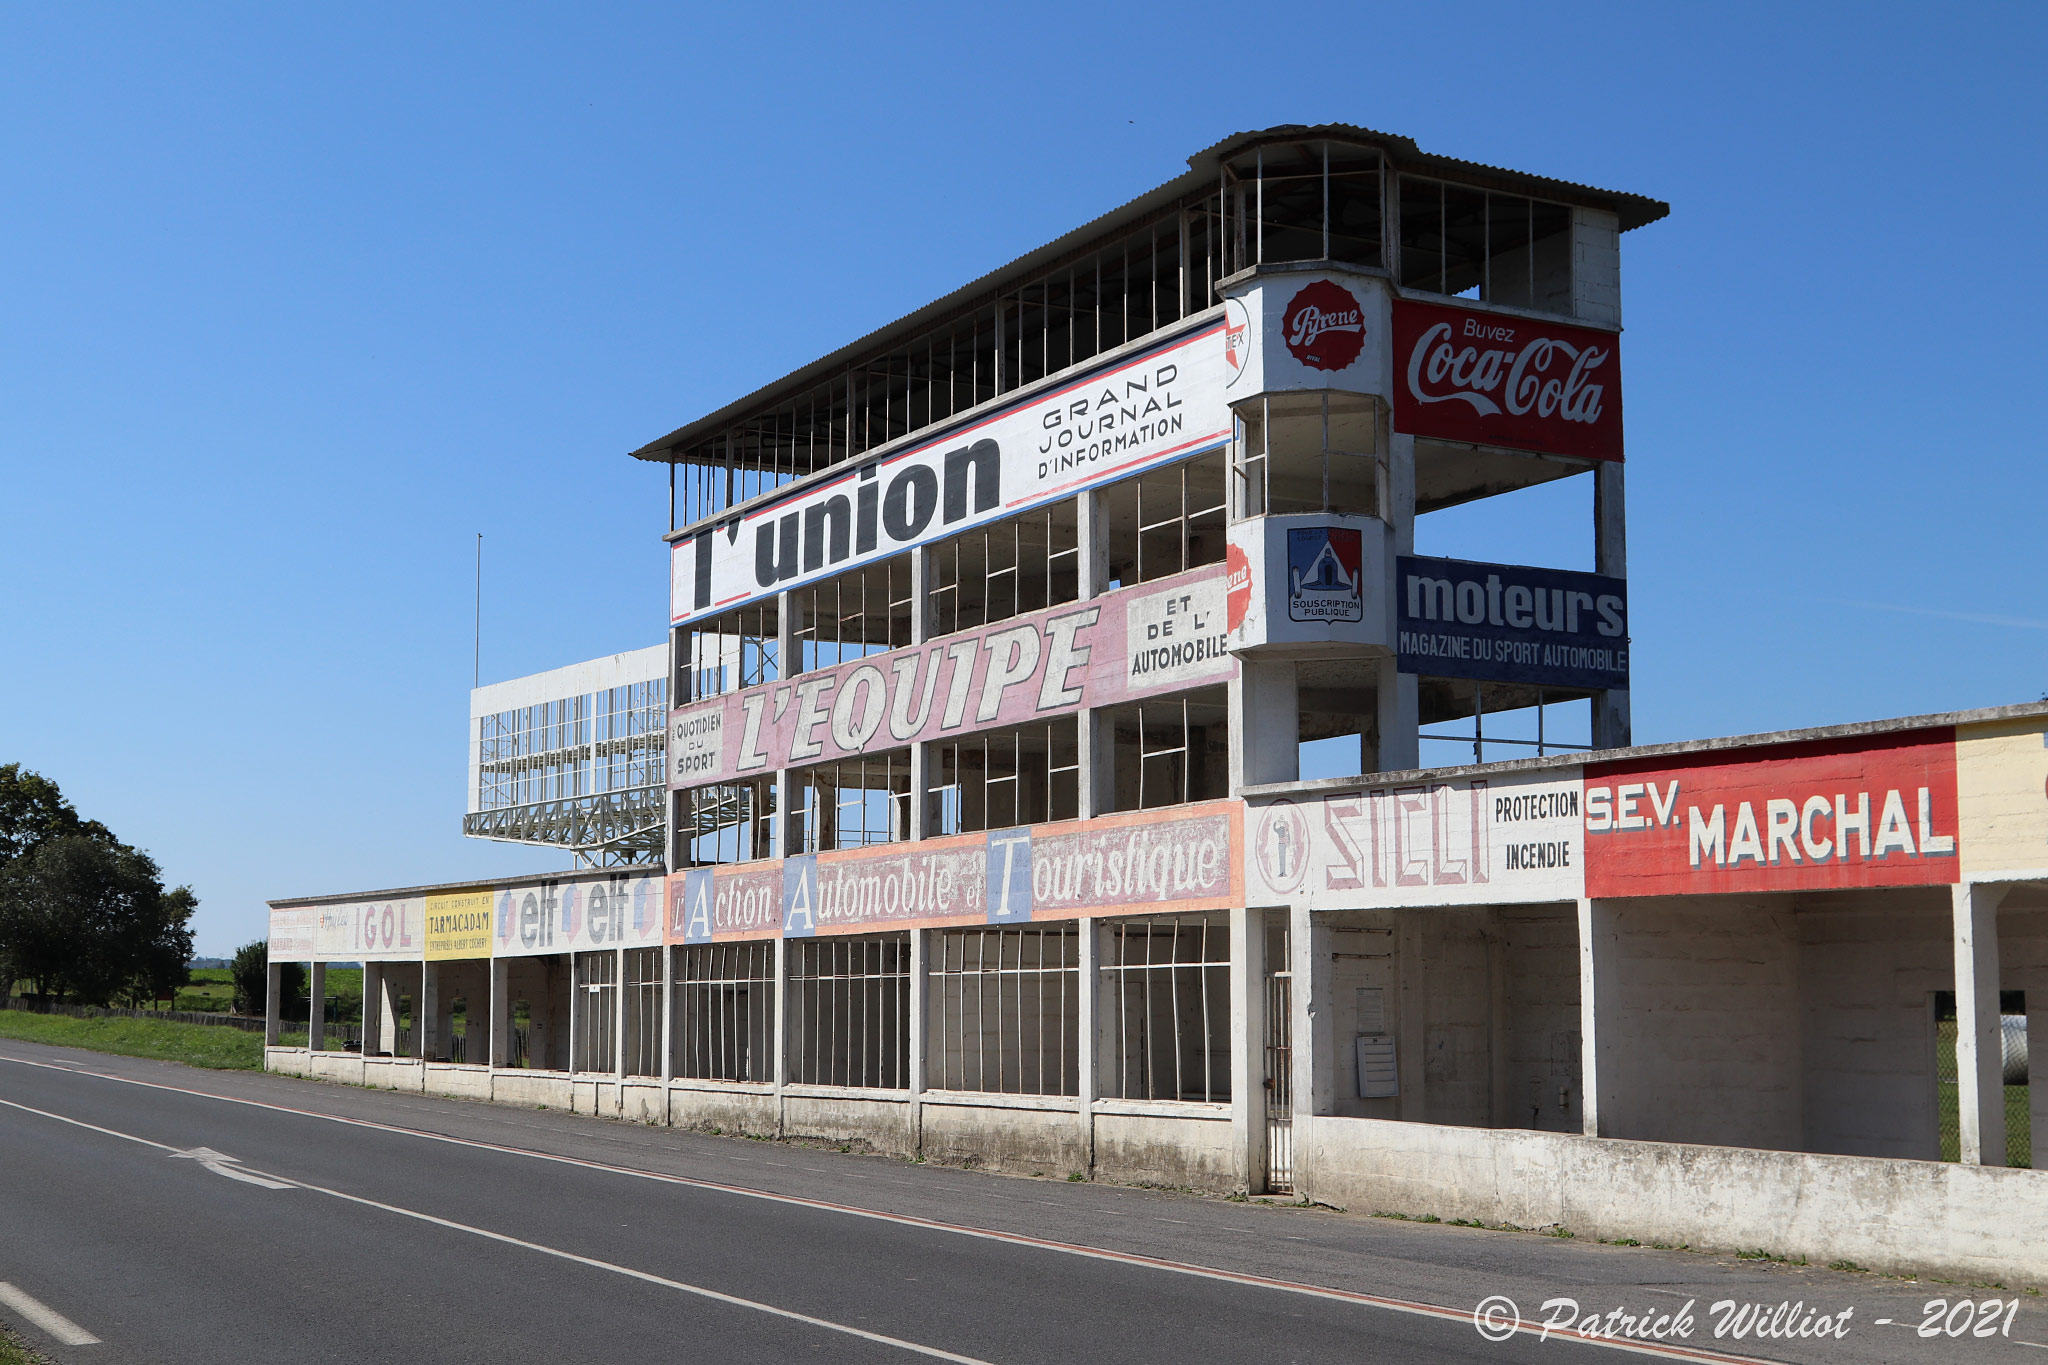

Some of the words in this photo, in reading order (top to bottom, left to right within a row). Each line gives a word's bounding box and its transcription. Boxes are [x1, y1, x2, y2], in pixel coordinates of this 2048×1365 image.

[1289, 305, 1361, 346] Pyrene
[1464, 318, 1515, 342] Buvez
[1408, 322, 1609, 424] Coca-Cola
[1043, 364, 1177, 430] GRAND
[1039, 392, 1182, 454] JOURNAL
[1039, 413, 1182, 479] D'INFORMATION
[1167, 595, 1191, 616] ET
[1293, 600, 1360, 609] SOUSCRIPTION
[1305, 609, 1350, 617] PUBLIQUE
[1406, 574, 1623, 637] moteurs
[1147, 620, 1173, 640] DE
[1194, 611, 1210, 630] L'
[1132, 633, 1228, 676] AUTOMOBILE
[1400, 631, 1471, 659] MAGAZINE
[1473, 638, 1492, 661] DU
[1495, 640, 1540, 665] SPORT
[1543, 645, 1627, 672] AUTOMOBILE
[736, 606, 1101, 773] L'EQUIPE
[677, 713, 721, 740] QUOTIDIEN
[689, 740, 703, 750] DU
[678, 752, 715, 774] SPORT
[1496, 791, 1579, 822] PROTECTION
[1585, 780, 1681, 833] S.E.V.
[1689, 786, 1956, 868] MARCHAL
[1506, 841, 1570, 870] INCENDIE
[785, 855, 952, 931] Automobile
[991, 830, 1218, 916] Touristique
[430, 901, 449, 910] CIRCUIT
[452, 897, 479, 908] CONSTRUIT
[482, 896, 489, 905] EN
[430, 912, 489, 934] TARMACADAM
[520, 879, 558, 949] elf
[587, 873, 630, 944] elf
[355, 904, 411, 950] IGOL
